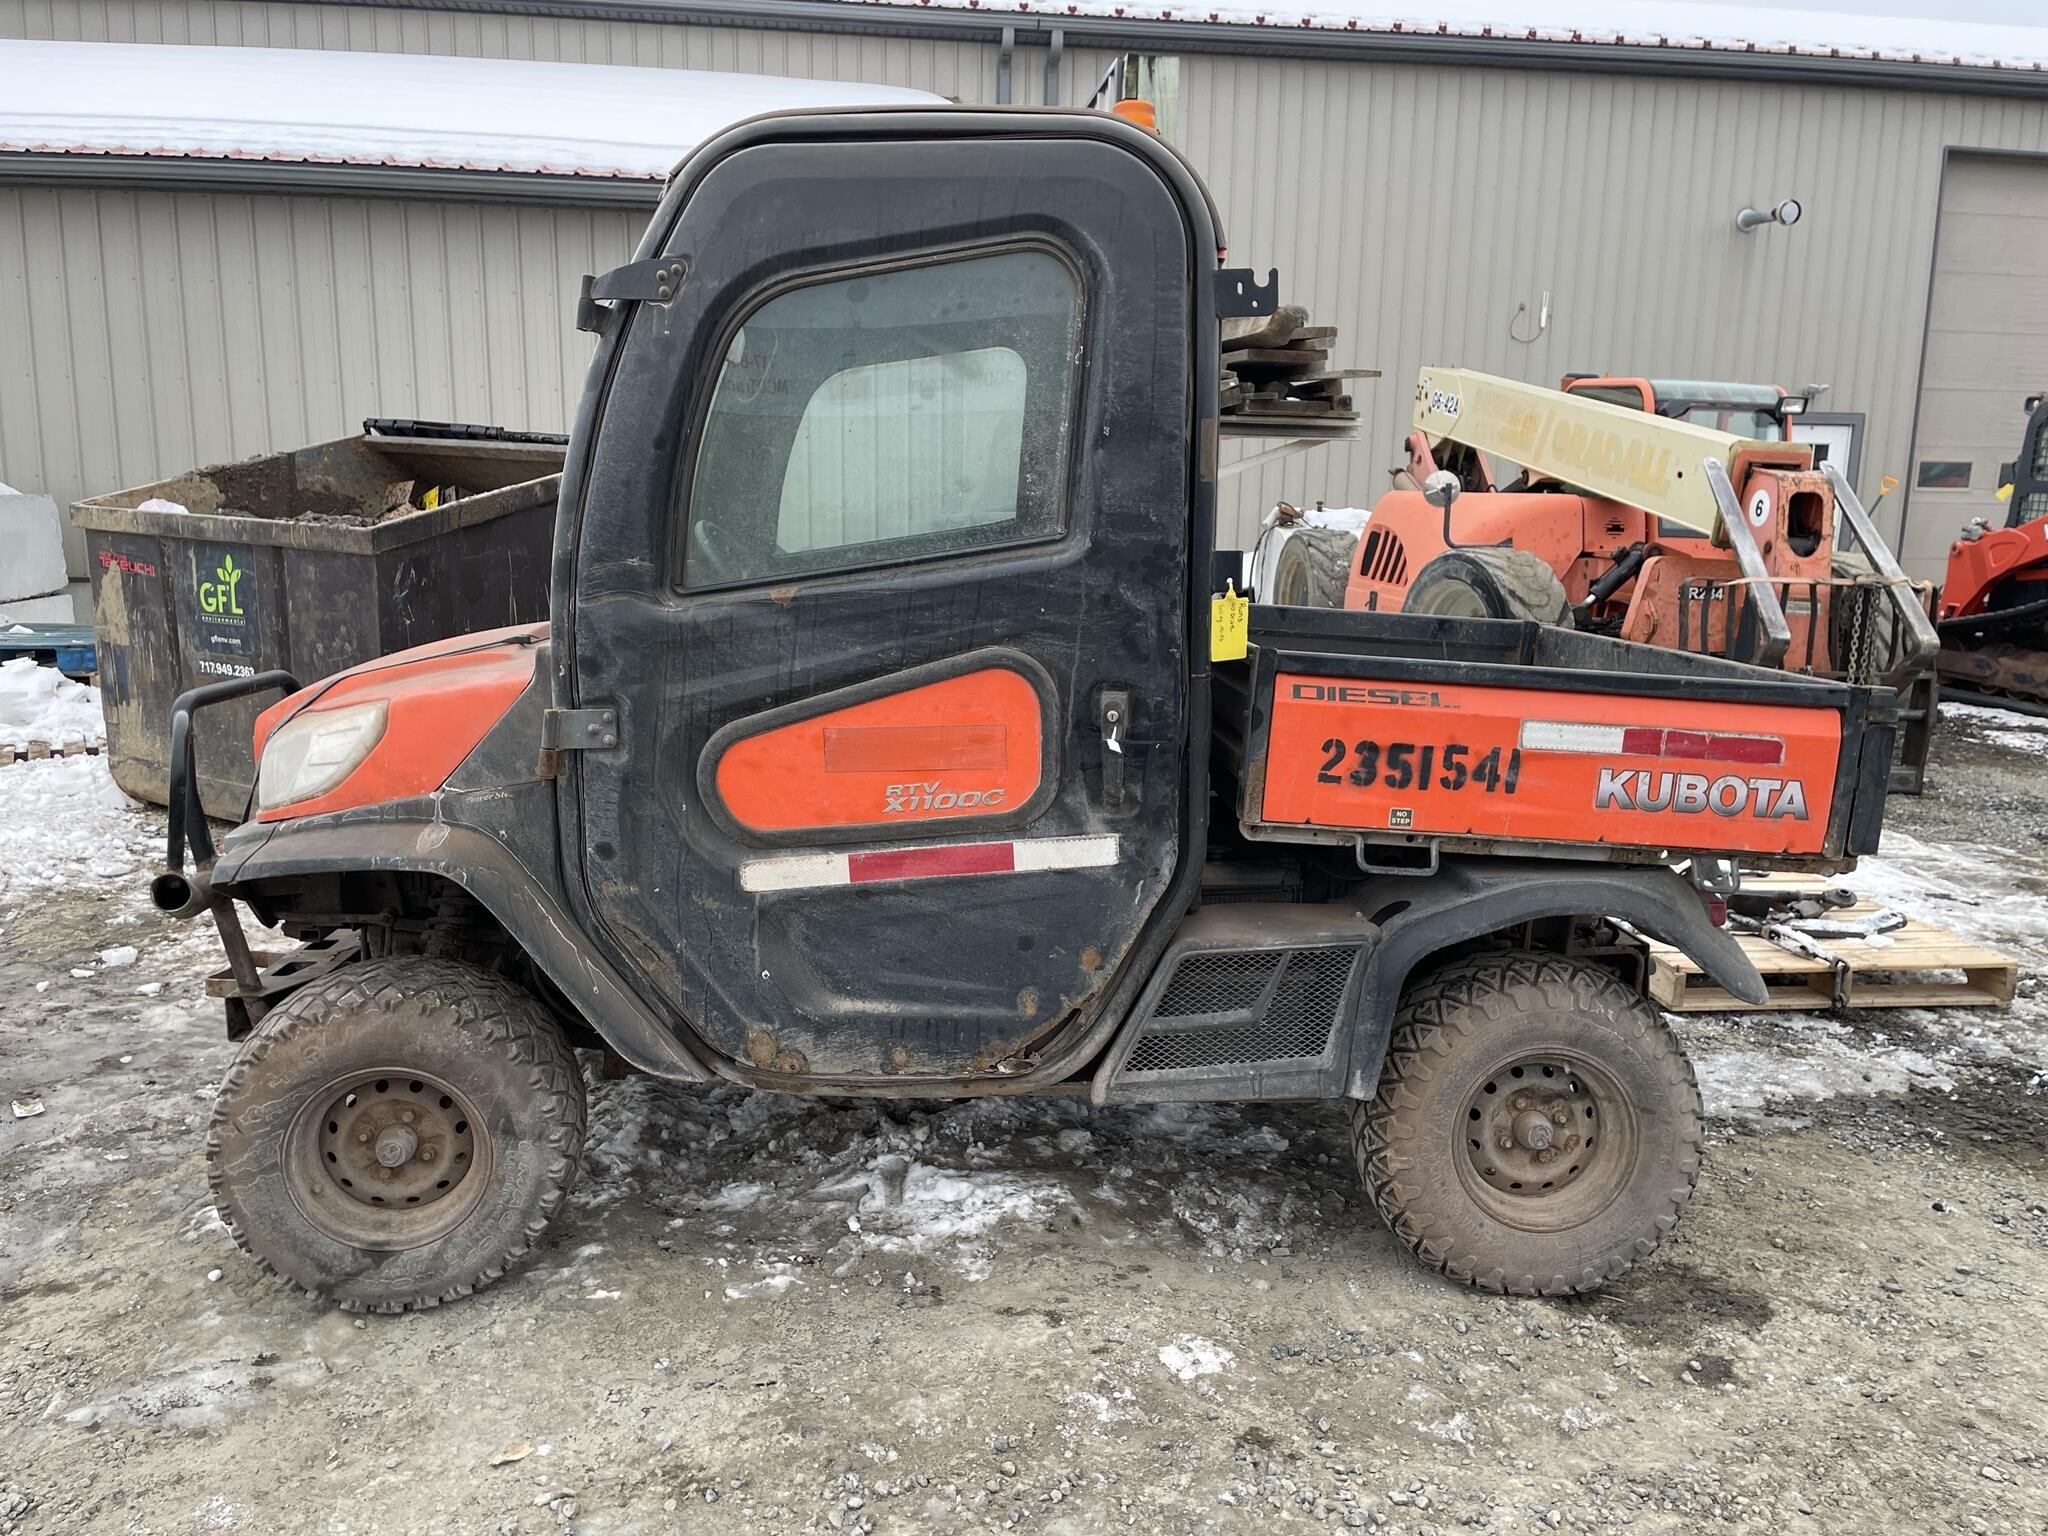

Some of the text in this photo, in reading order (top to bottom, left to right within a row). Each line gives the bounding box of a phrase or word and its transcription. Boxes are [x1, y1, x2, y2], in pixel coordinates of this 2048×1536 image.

[1755, 499, 1764, 517] 6
[200, 578, 243, 615] GFL
[882, 789, 1005, 813] X1100C
[886, 782, 942, 797] RTV
[1595, 767, 1809, 820] KUBOTA
